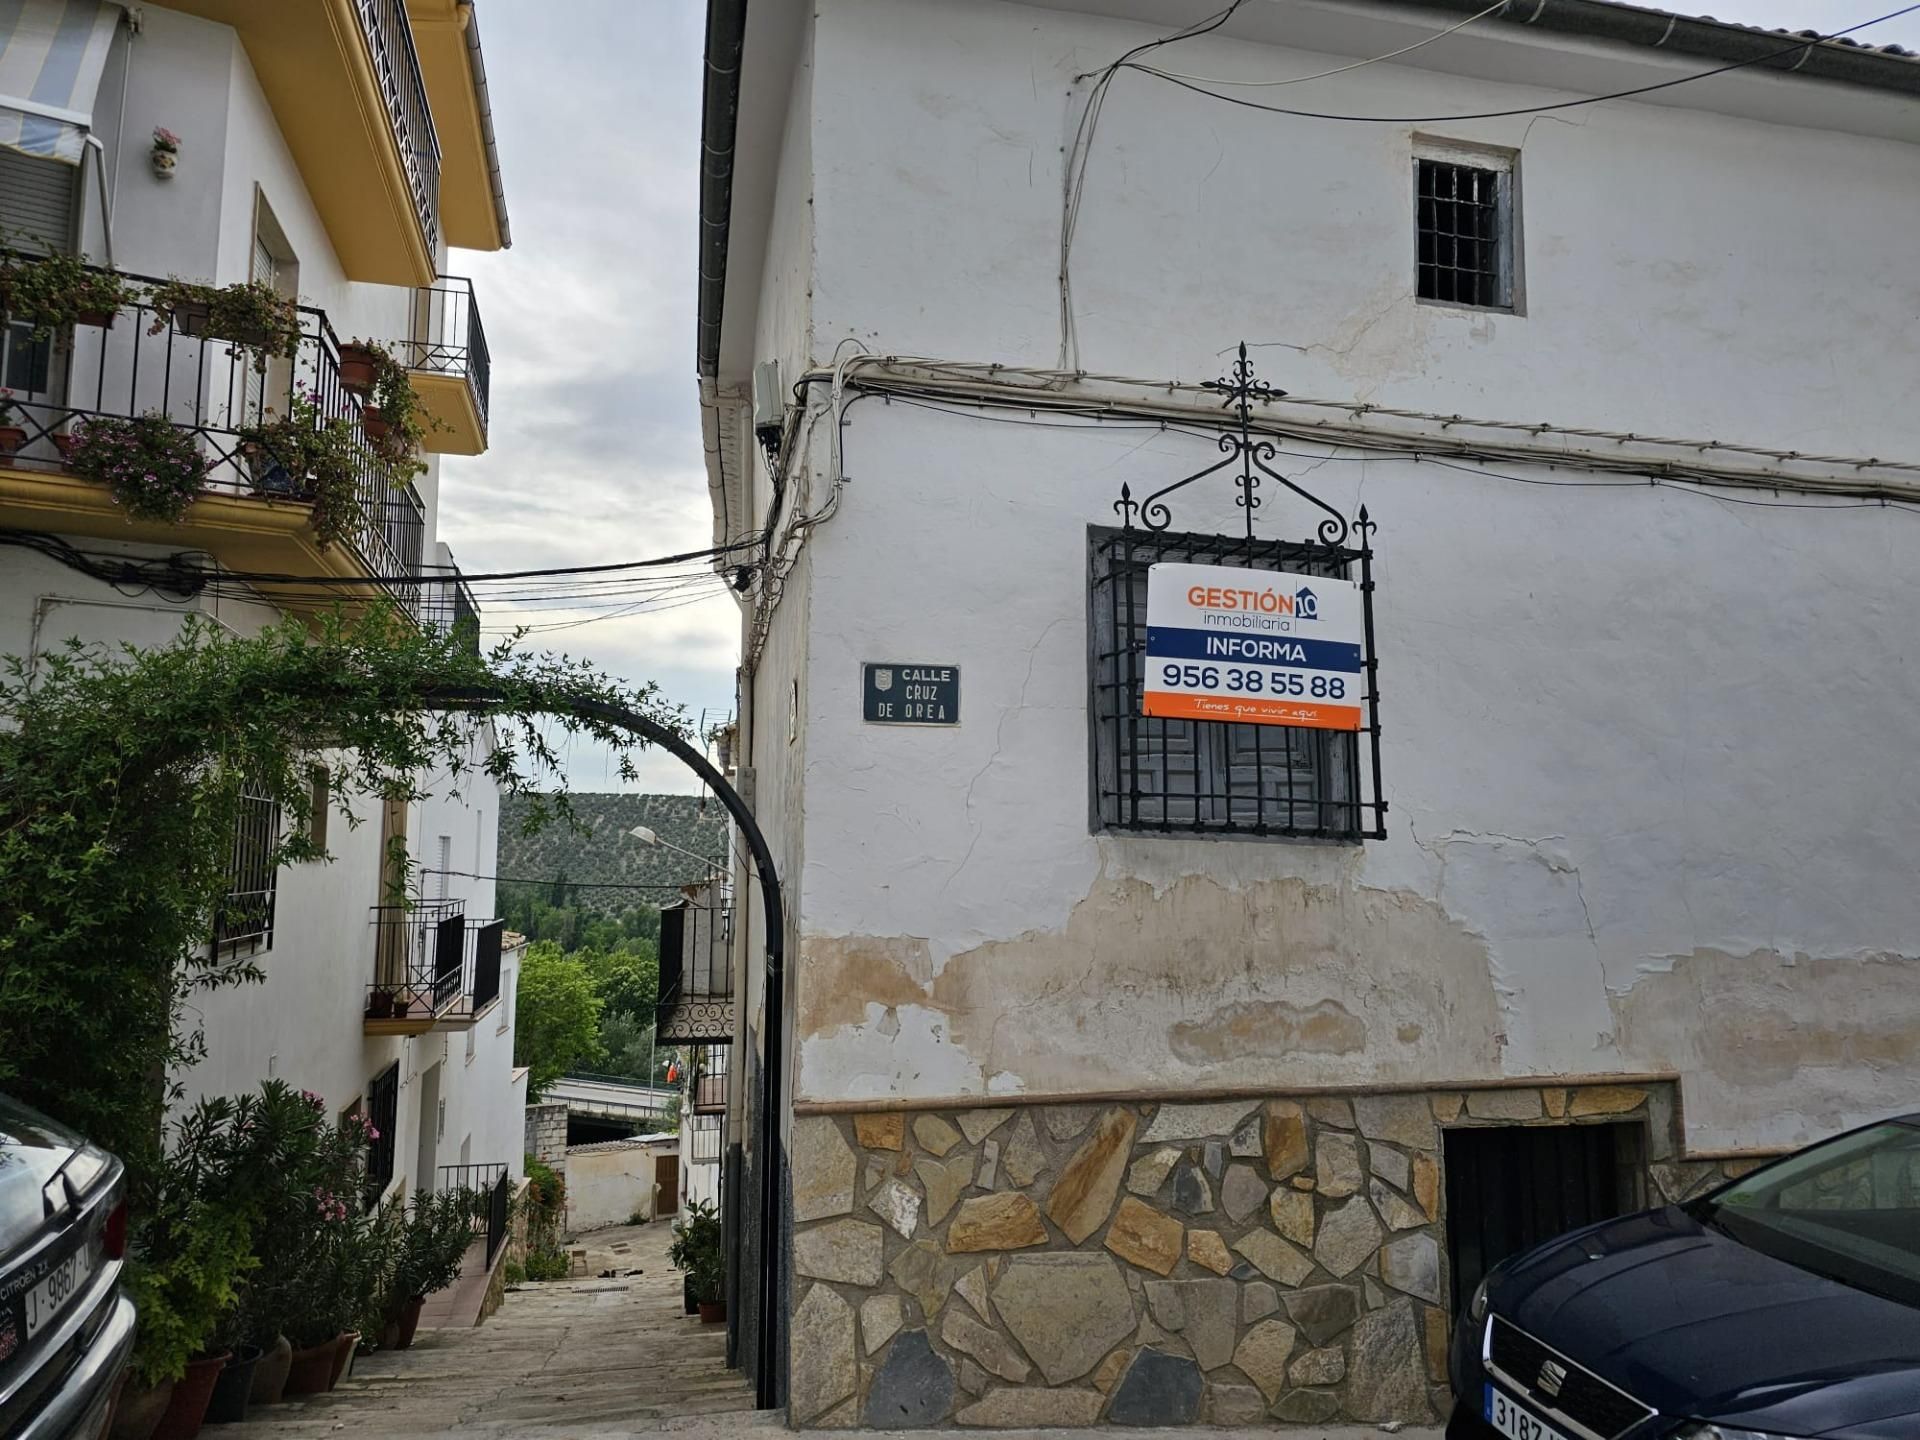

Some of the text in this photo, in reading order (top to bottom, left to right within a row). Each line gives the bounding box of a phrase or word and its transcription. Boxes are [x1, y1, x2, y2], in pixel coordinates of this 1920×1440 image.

[1187, 586, 1318, 618] GESTIÓN 10
[1204, 611, 1291, 632] inmobiliaria
[1206, 637, 1307, 662] INFORMA
[902, 669, 951, 682] CALLE
[1163, 664, 1345, 700] 956 38 55 88
[906, 684, 938, 700] CRUZ
[878, 703, 945, 720] DE OREA
[1194, 698, 1230, 711] Tienes
[1234, 705, 1257, 718] que
[1261, 706, 1287, 716] vivir
[1497, 1398, 1542, 1440] 3187
